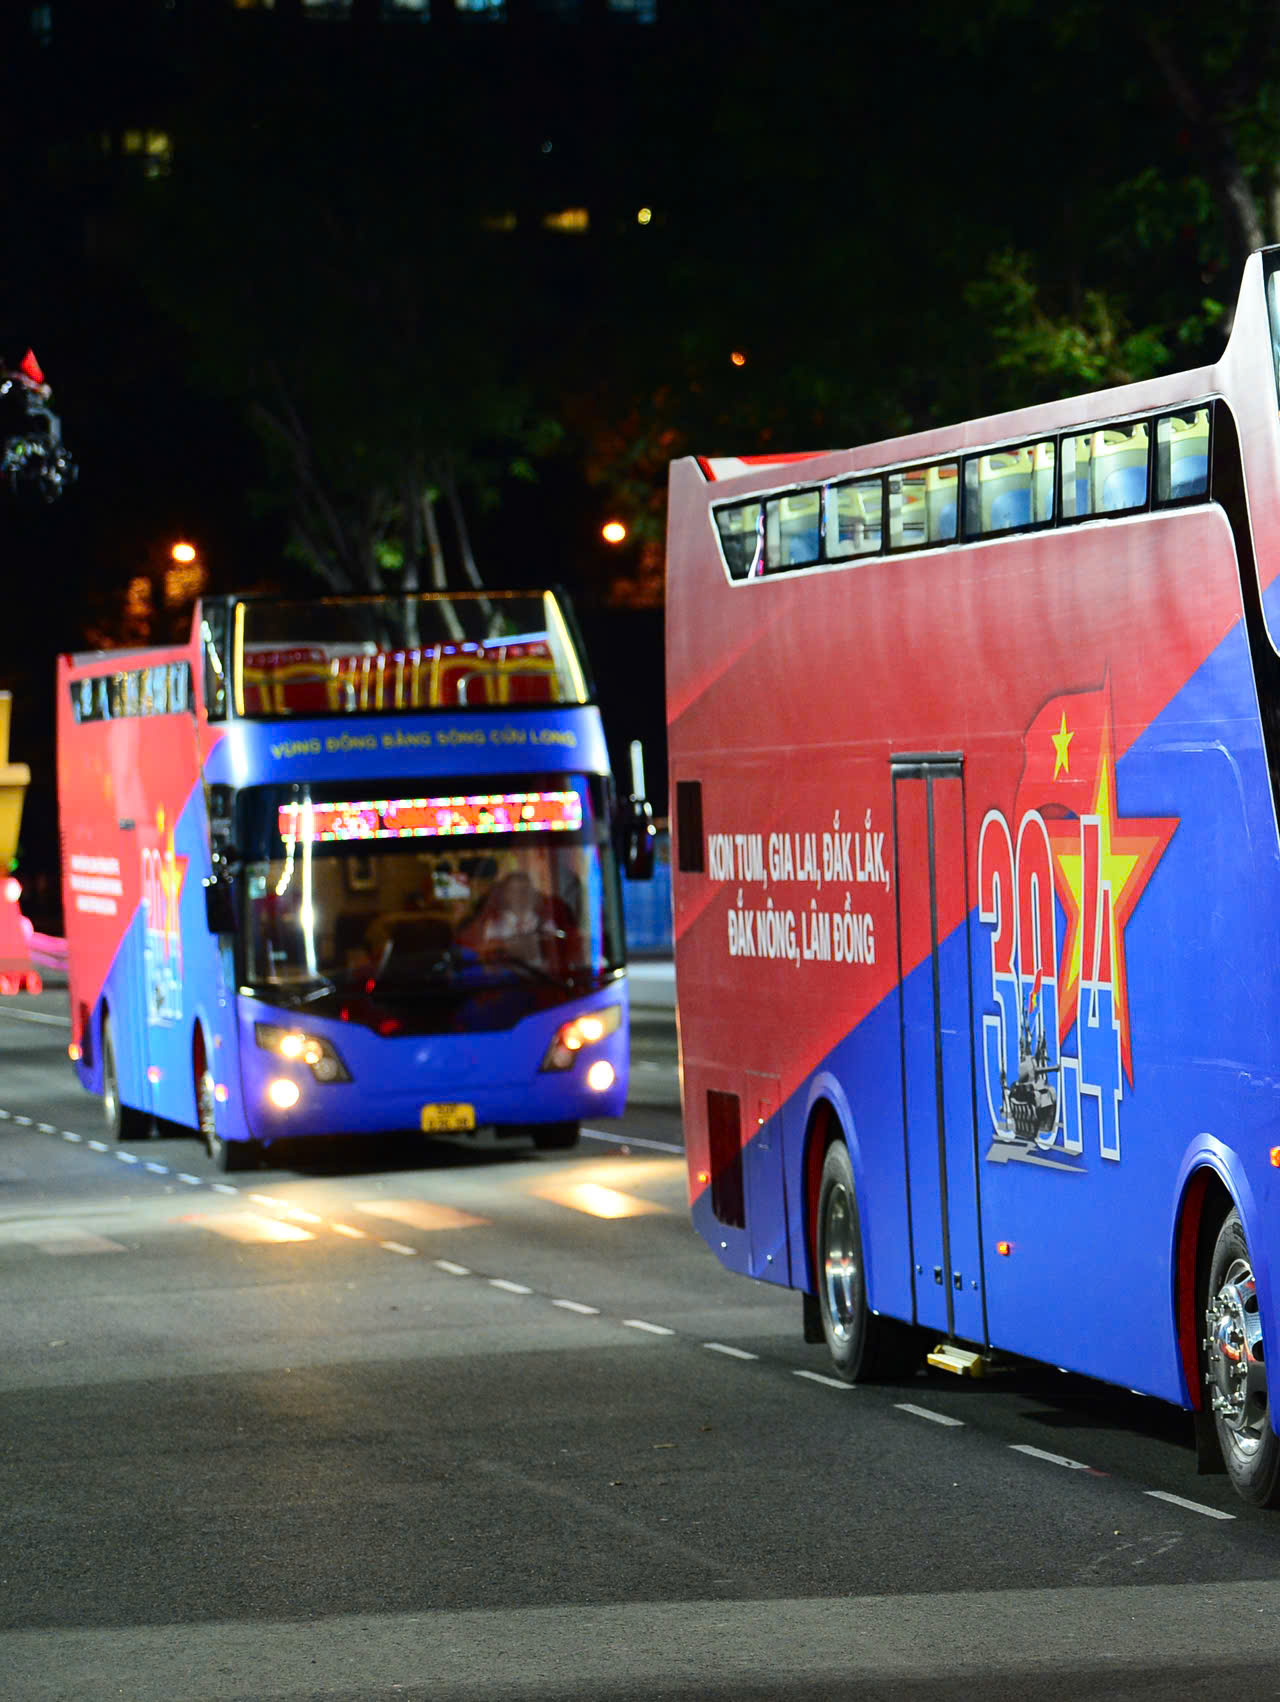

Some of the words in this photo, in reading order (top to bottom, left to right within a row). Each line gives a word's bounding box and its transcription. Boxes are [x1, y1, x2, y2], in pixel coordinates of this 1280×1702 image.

[708, 833, 734, 881] KON
[735, 834, 768, 890] TUM,
[768, 832, 795, 882] GIA
[795, 833, 822, 891] LAI,
[756, 897, 800, 968] NÔNG,
[801, 898, 831, 961] LÂM
